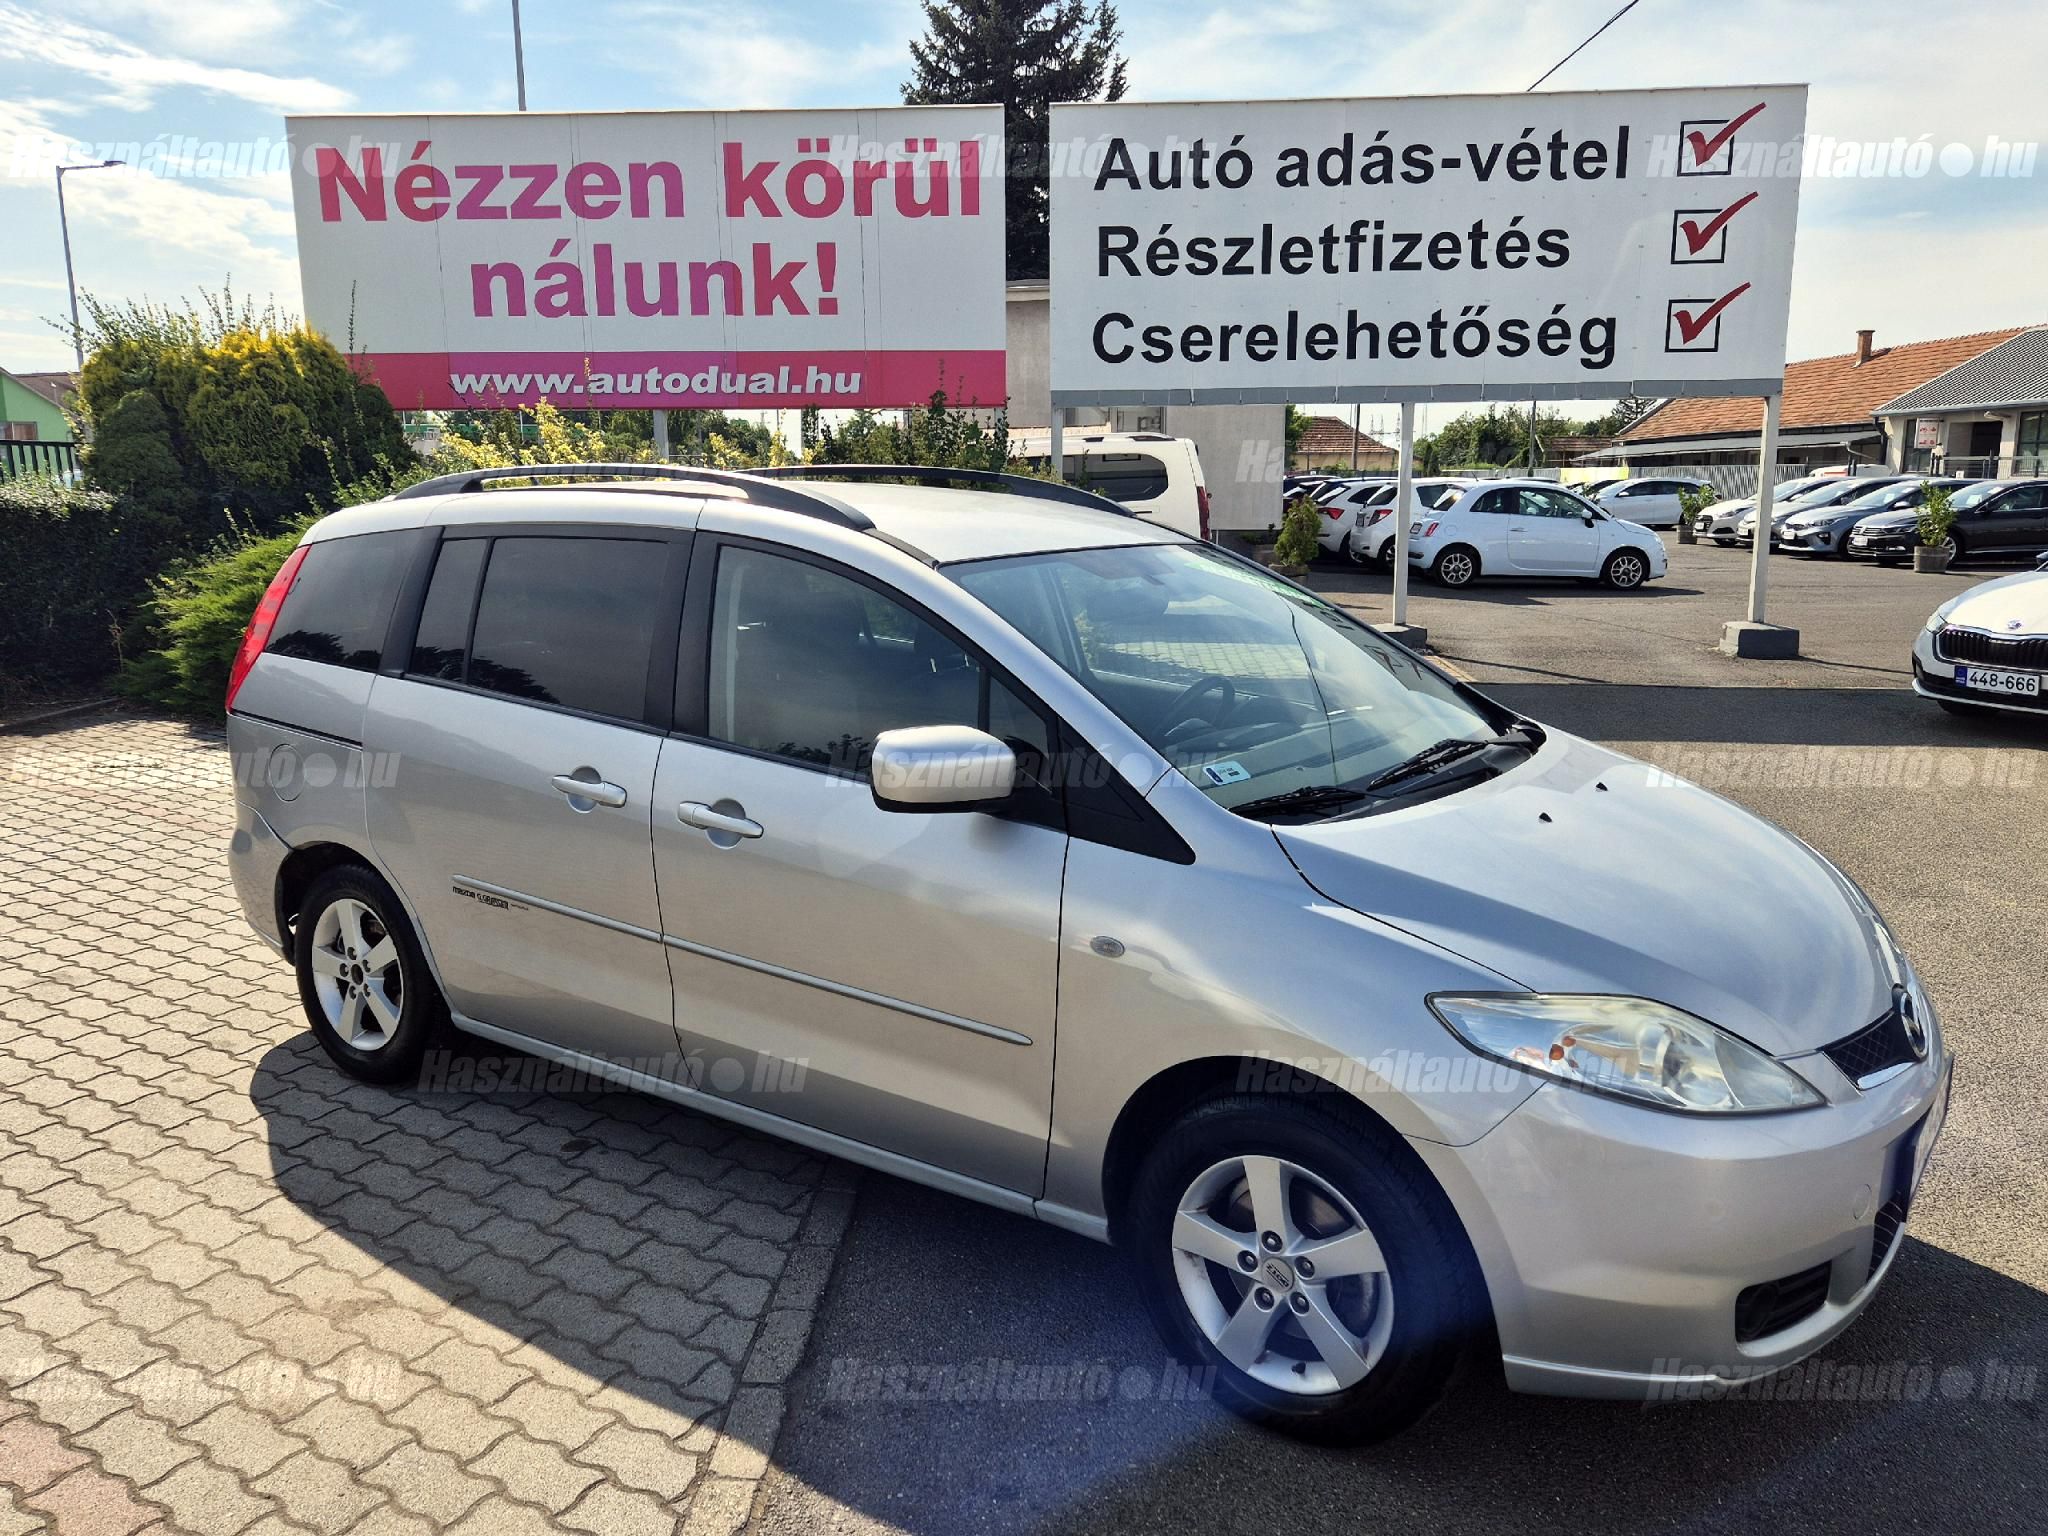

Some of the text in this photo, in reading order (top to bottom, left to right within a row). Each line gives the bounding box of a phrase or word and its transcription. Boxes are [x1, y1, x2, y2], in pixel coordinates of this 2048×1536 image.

[315, 137, 981, 222] Nézzen körül
[1094, 124, 1630, 191] Autó adás-vétel
[470, 238, 840, 318] nálunk!
[1098, 214, 1571, 278] Részletfizetés
[1092, 302, 1618, 371] Cserelehetőség
[449, 365, 861, 395] www.autodual.hu
[1969, 671, 2036, 692] 448-666
